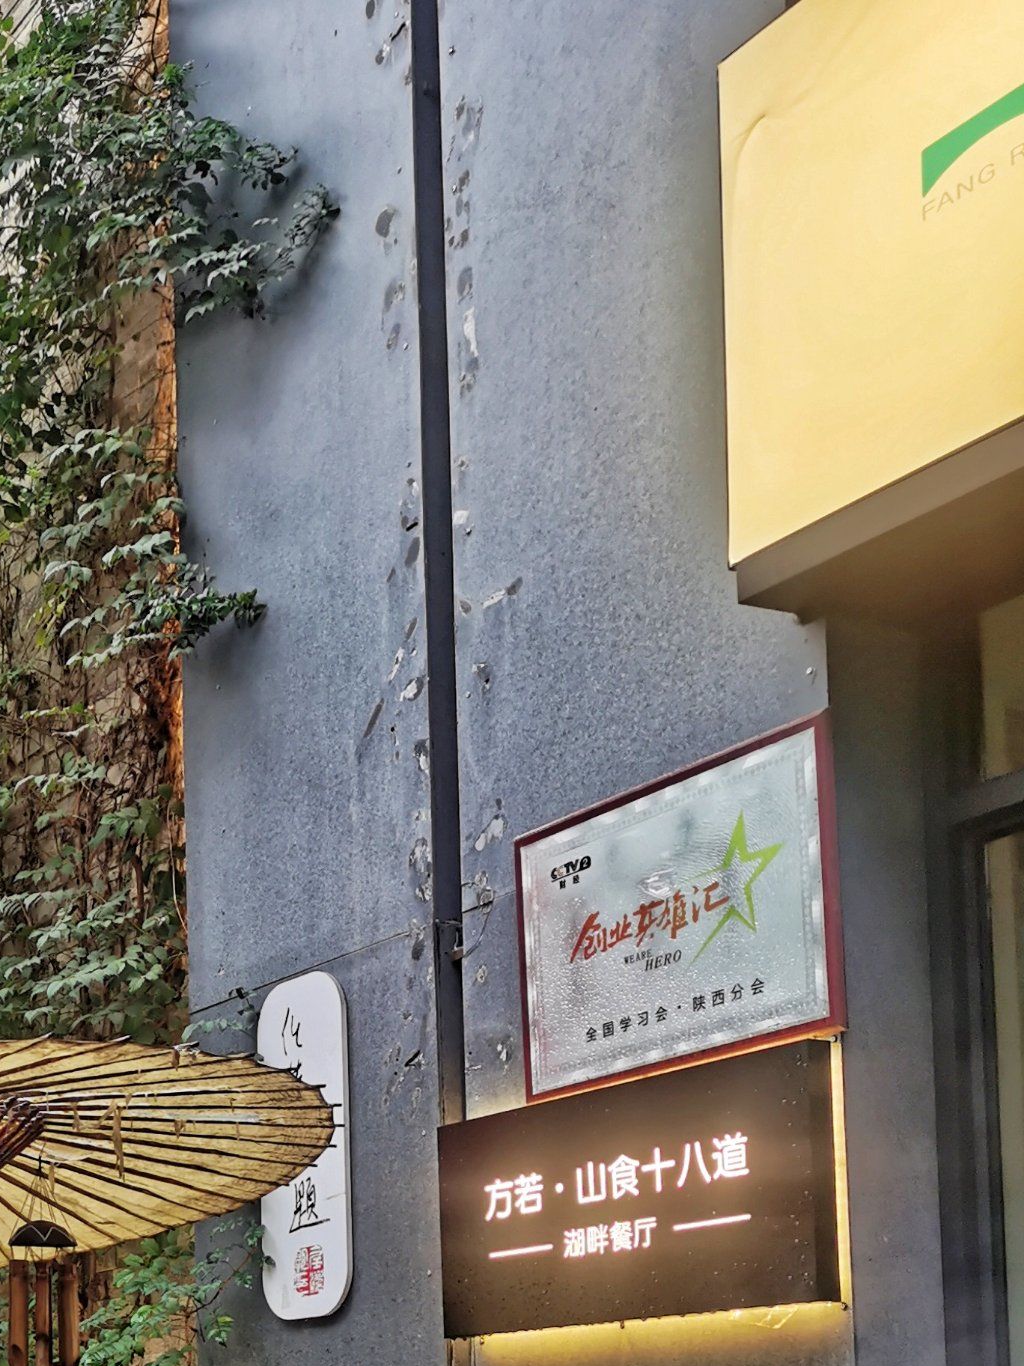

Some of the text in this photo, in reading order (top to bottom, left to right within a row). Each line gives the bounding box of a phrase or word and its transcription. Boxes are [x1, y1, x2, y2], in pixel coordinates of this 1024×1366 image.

[921, 162, 996, 222] FANG
[569, 881, 730, 964] 创业英雄汇
[645, 949, 682, 972] HERO
[484, 1131, 750, 1222] 方若·山食十八道
[563, 1216, 657, 1258] 湖畔餐厅
